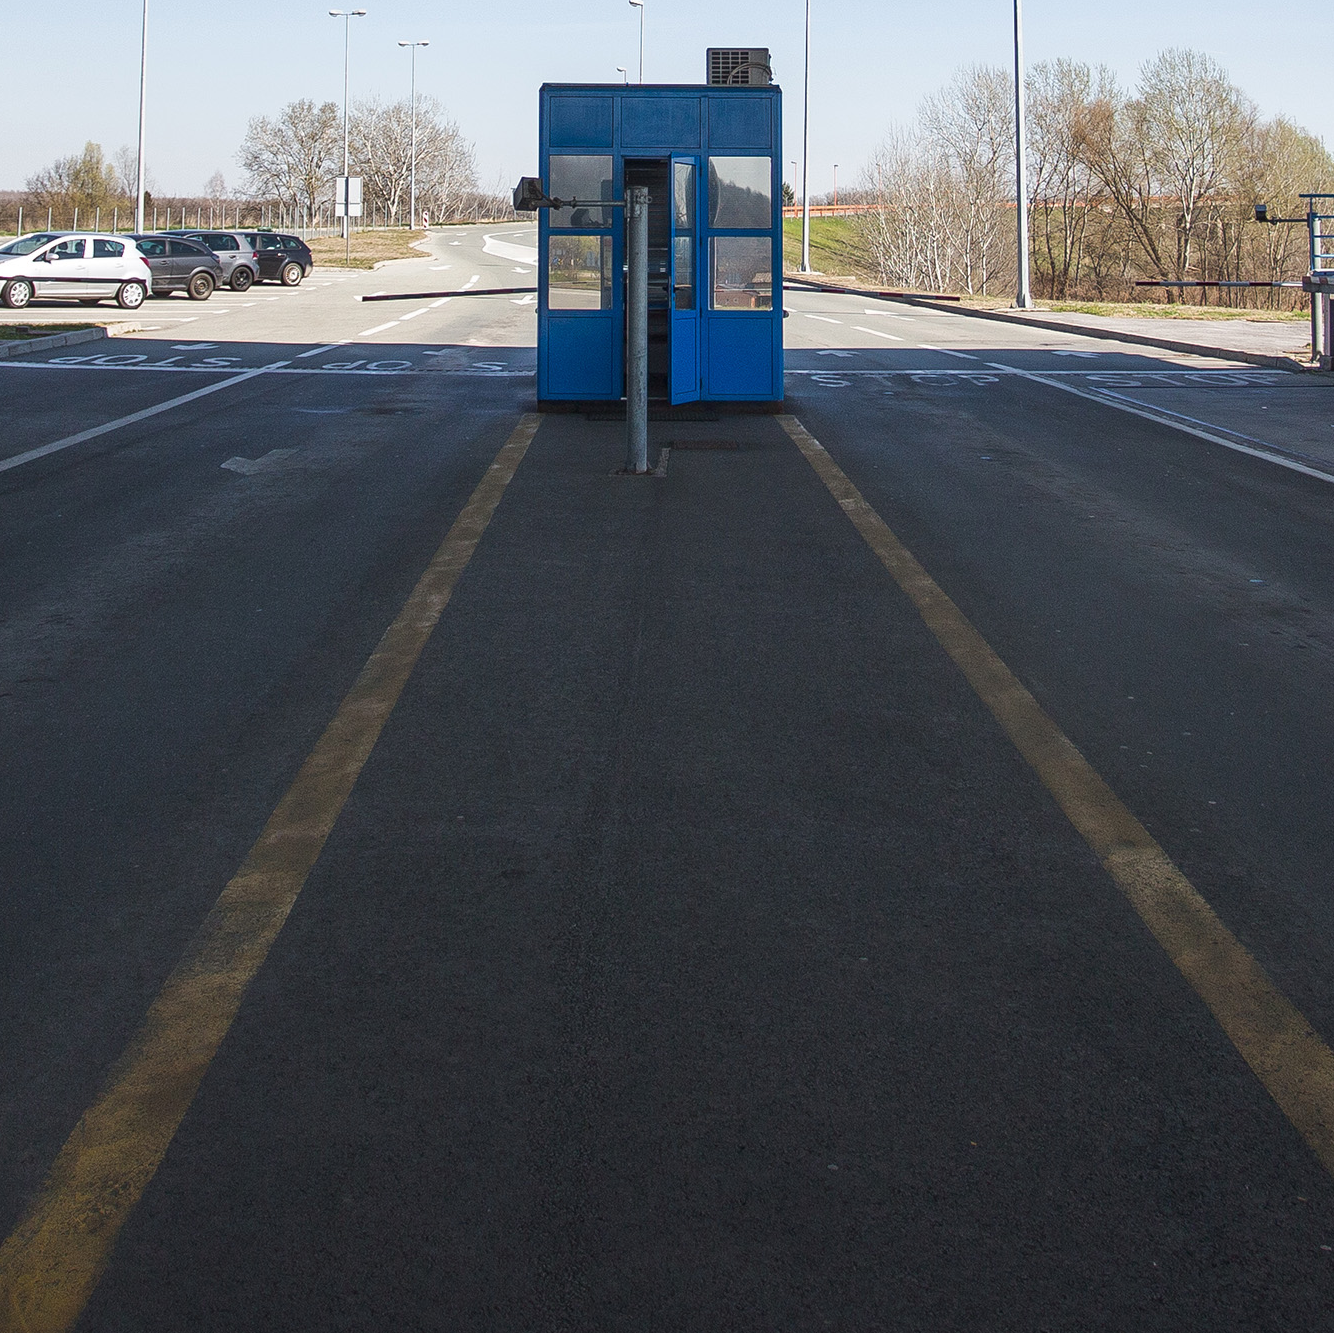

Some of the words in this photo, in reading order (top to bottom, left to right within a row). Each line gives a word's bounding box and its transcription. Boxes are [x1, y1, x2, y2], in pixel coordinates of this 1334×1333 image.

[47, 353, 243, 367] STOP
[321, 360, 509, 371] SOP
[1085, 373, 1278, 387] STOP
